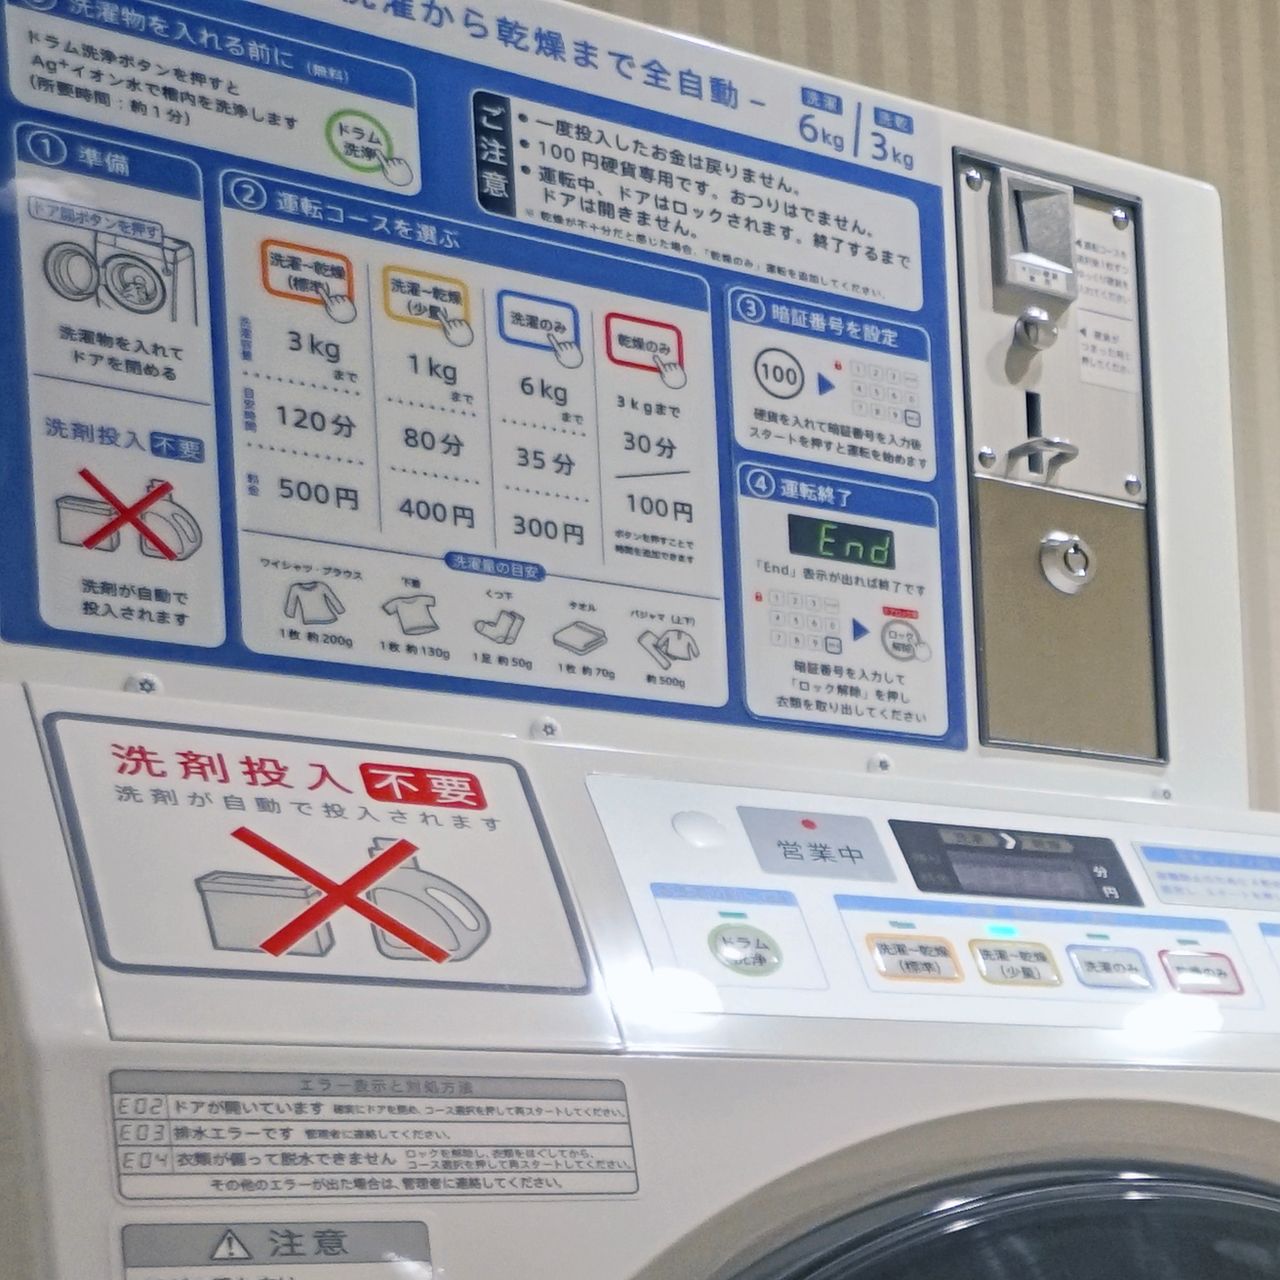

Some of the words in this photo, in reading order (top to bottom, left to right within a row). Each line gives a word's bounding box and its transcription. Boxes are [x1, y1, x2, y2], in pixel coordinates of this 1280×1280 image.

[28, 30, 241, 96] ドラム洗浄ボタンを押すと
[337, 121, 382, 146] ドラム
[79, 149, 130, 176] 準備
[479, 106, 510, 199] ご注意
[535, 117, 800, 195] 一度投入したお金は戻りません。
[276, 190, 462, 249] 運転コースを選ぶ
[541, 187, 698, 239] ドアは開きません。
[509, 310, 567, 335] 洗濯のみ
[771, 303, 899, 349] 暗証番号を設定
[58, 325, 184, 361] 洗濯物を入れて
[616, 332, 672, 356] 乾燥のみ
[761, 362, 799, 386] 100
[44, 416, 147, 452] 洗剤投入
[780, 477, 852, 508] 運転終了
[816, 523, 892, 565] End
[81, 579, 189, 606] 洗剤が自動で
[81, 601, 190, 627] 投入されます
[110, 743, 354, 795] 洗剤投入
[370, 768, 479, 807] 不要
[113, 784, 502, 832] 洗剤が自動で投入されます
[776, 840, 864, 865] 営業中
[175, 1100, 325, 1115] ドアが開いています
[174, 1126, 294, 1141] 排水エラーです
[268, 1228, 350, 1258] 注意
